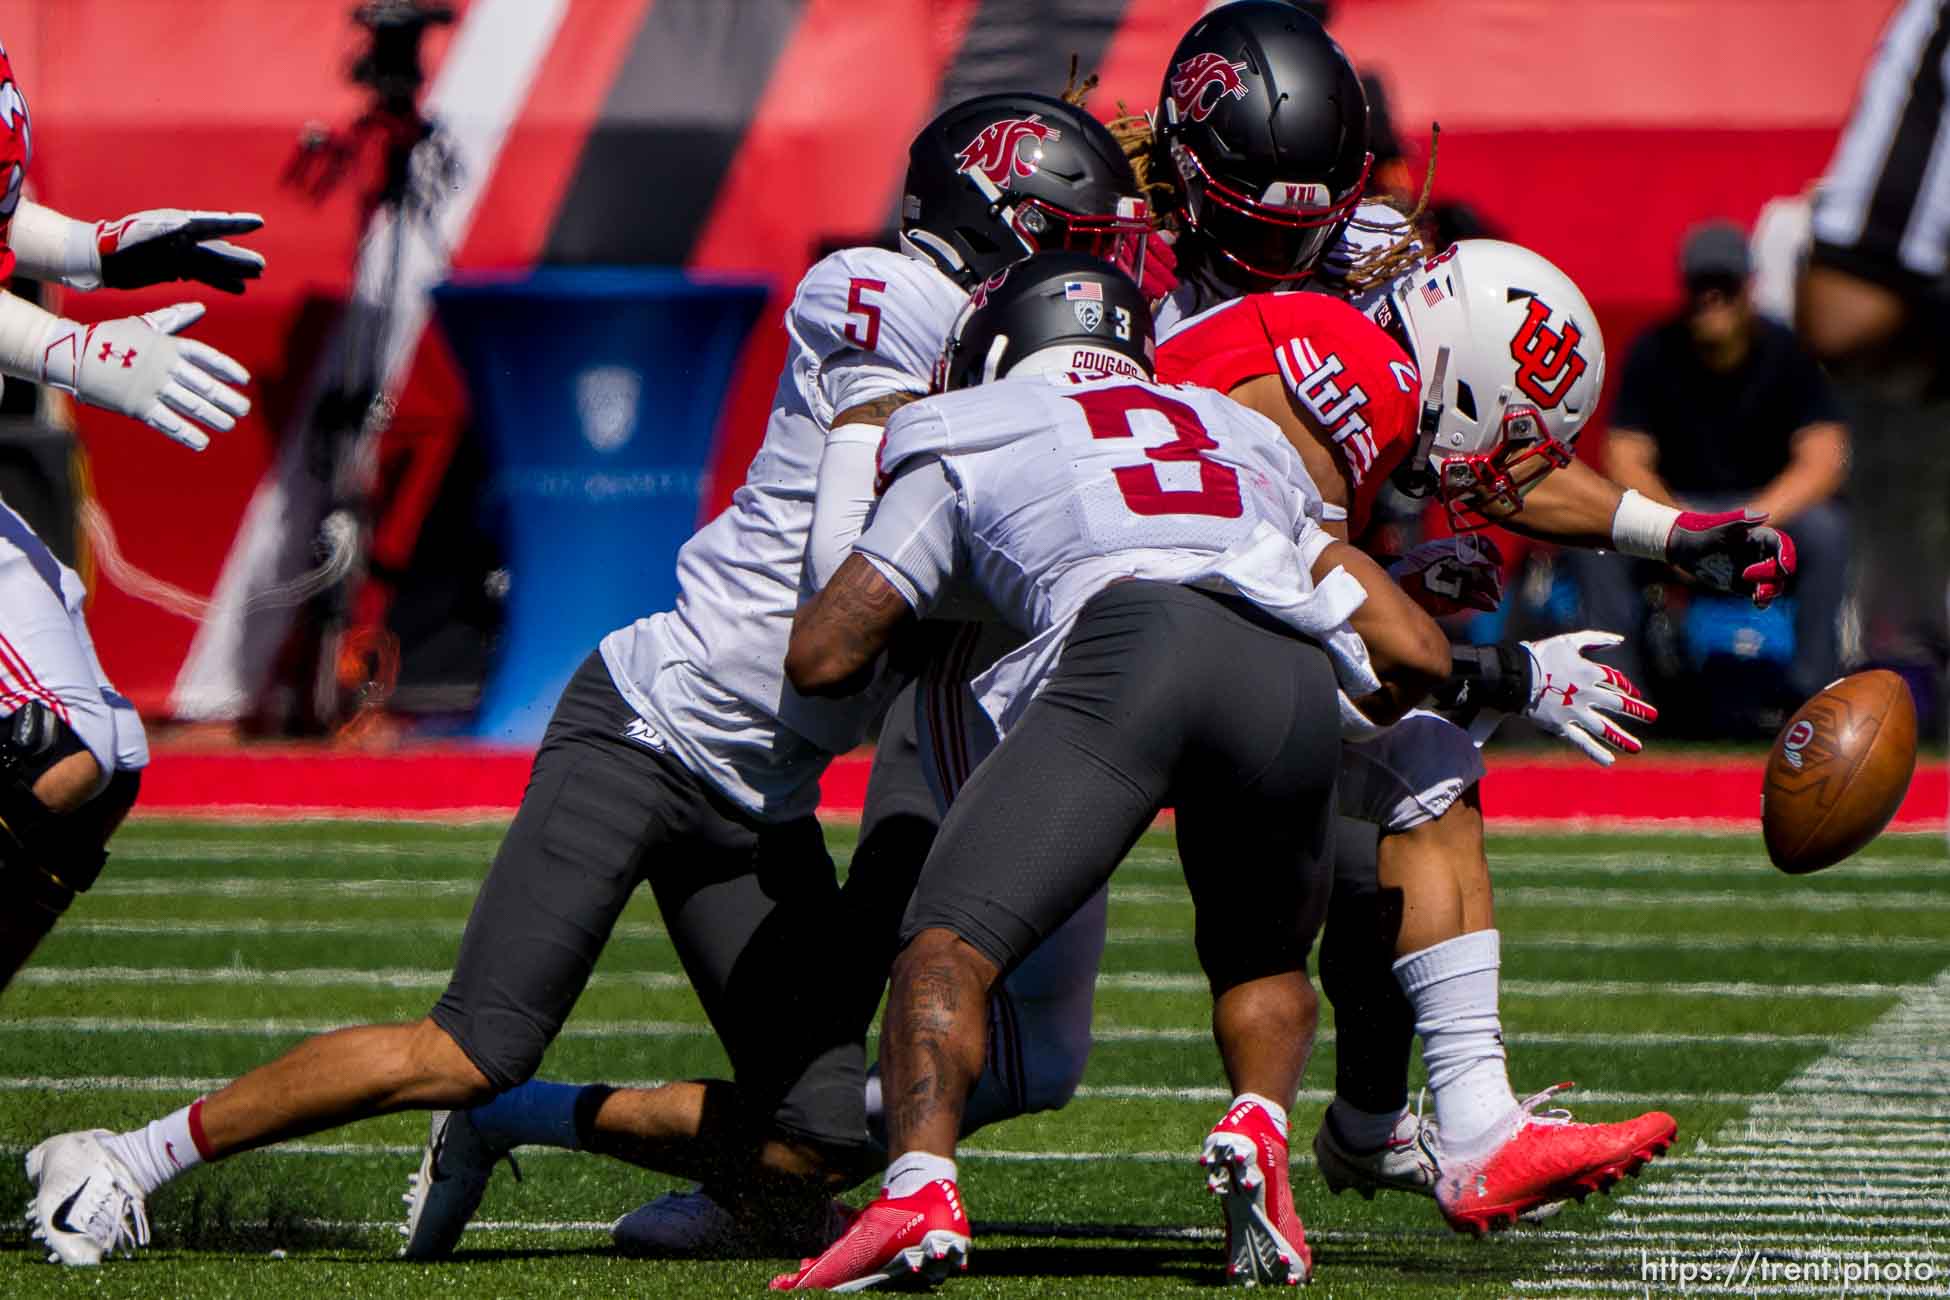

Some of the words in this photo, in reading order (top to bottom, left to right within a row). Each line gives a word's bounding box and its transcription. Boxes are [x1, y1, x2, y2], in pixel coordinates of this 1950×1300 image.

[844, 277, 886, 352] 5
[1114, 305, 1131, 341] 3
[1061, 384, 1244, 519] 3
